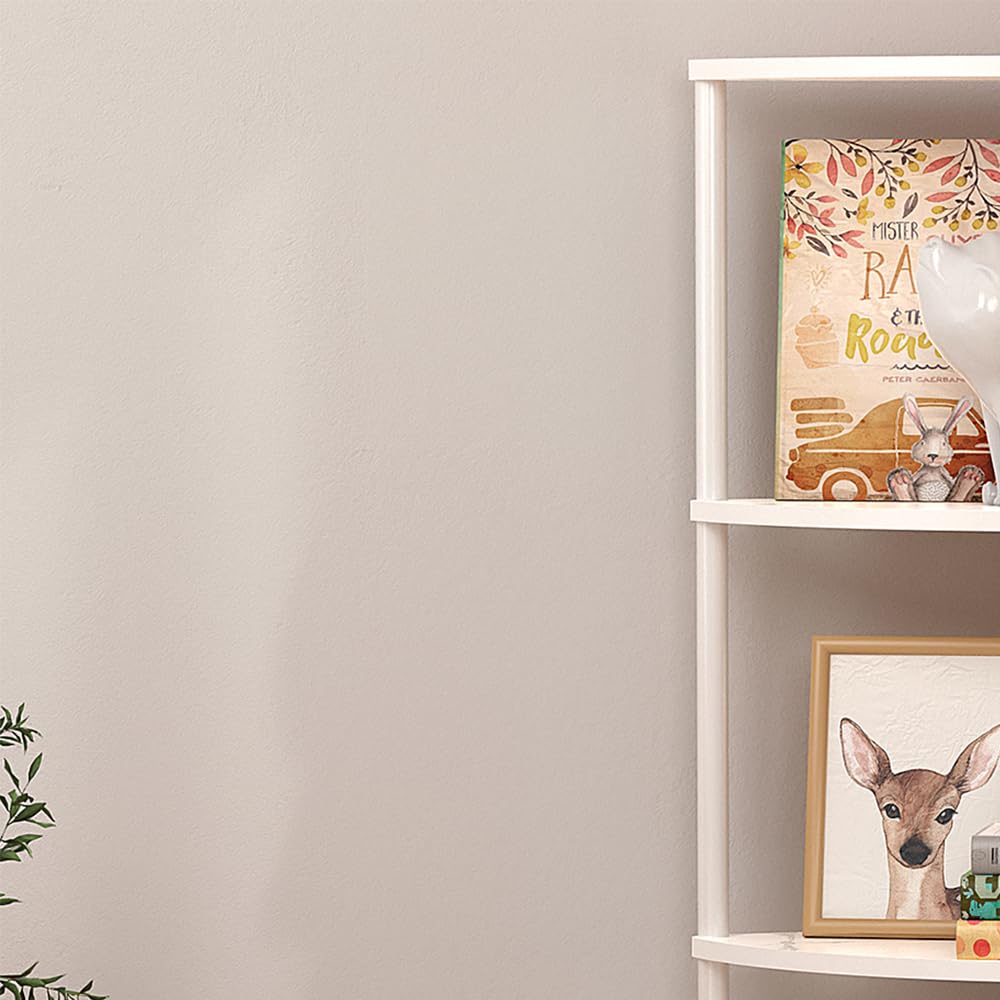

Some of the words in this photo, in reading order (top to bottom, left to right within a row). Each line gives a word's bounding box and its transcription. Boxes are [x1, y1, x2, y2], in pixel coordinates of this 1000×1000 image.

[872, 220, 920, 241] MISTER
[860, 244, 918, 300] RA
[882, 375, 912, 383] PETER
